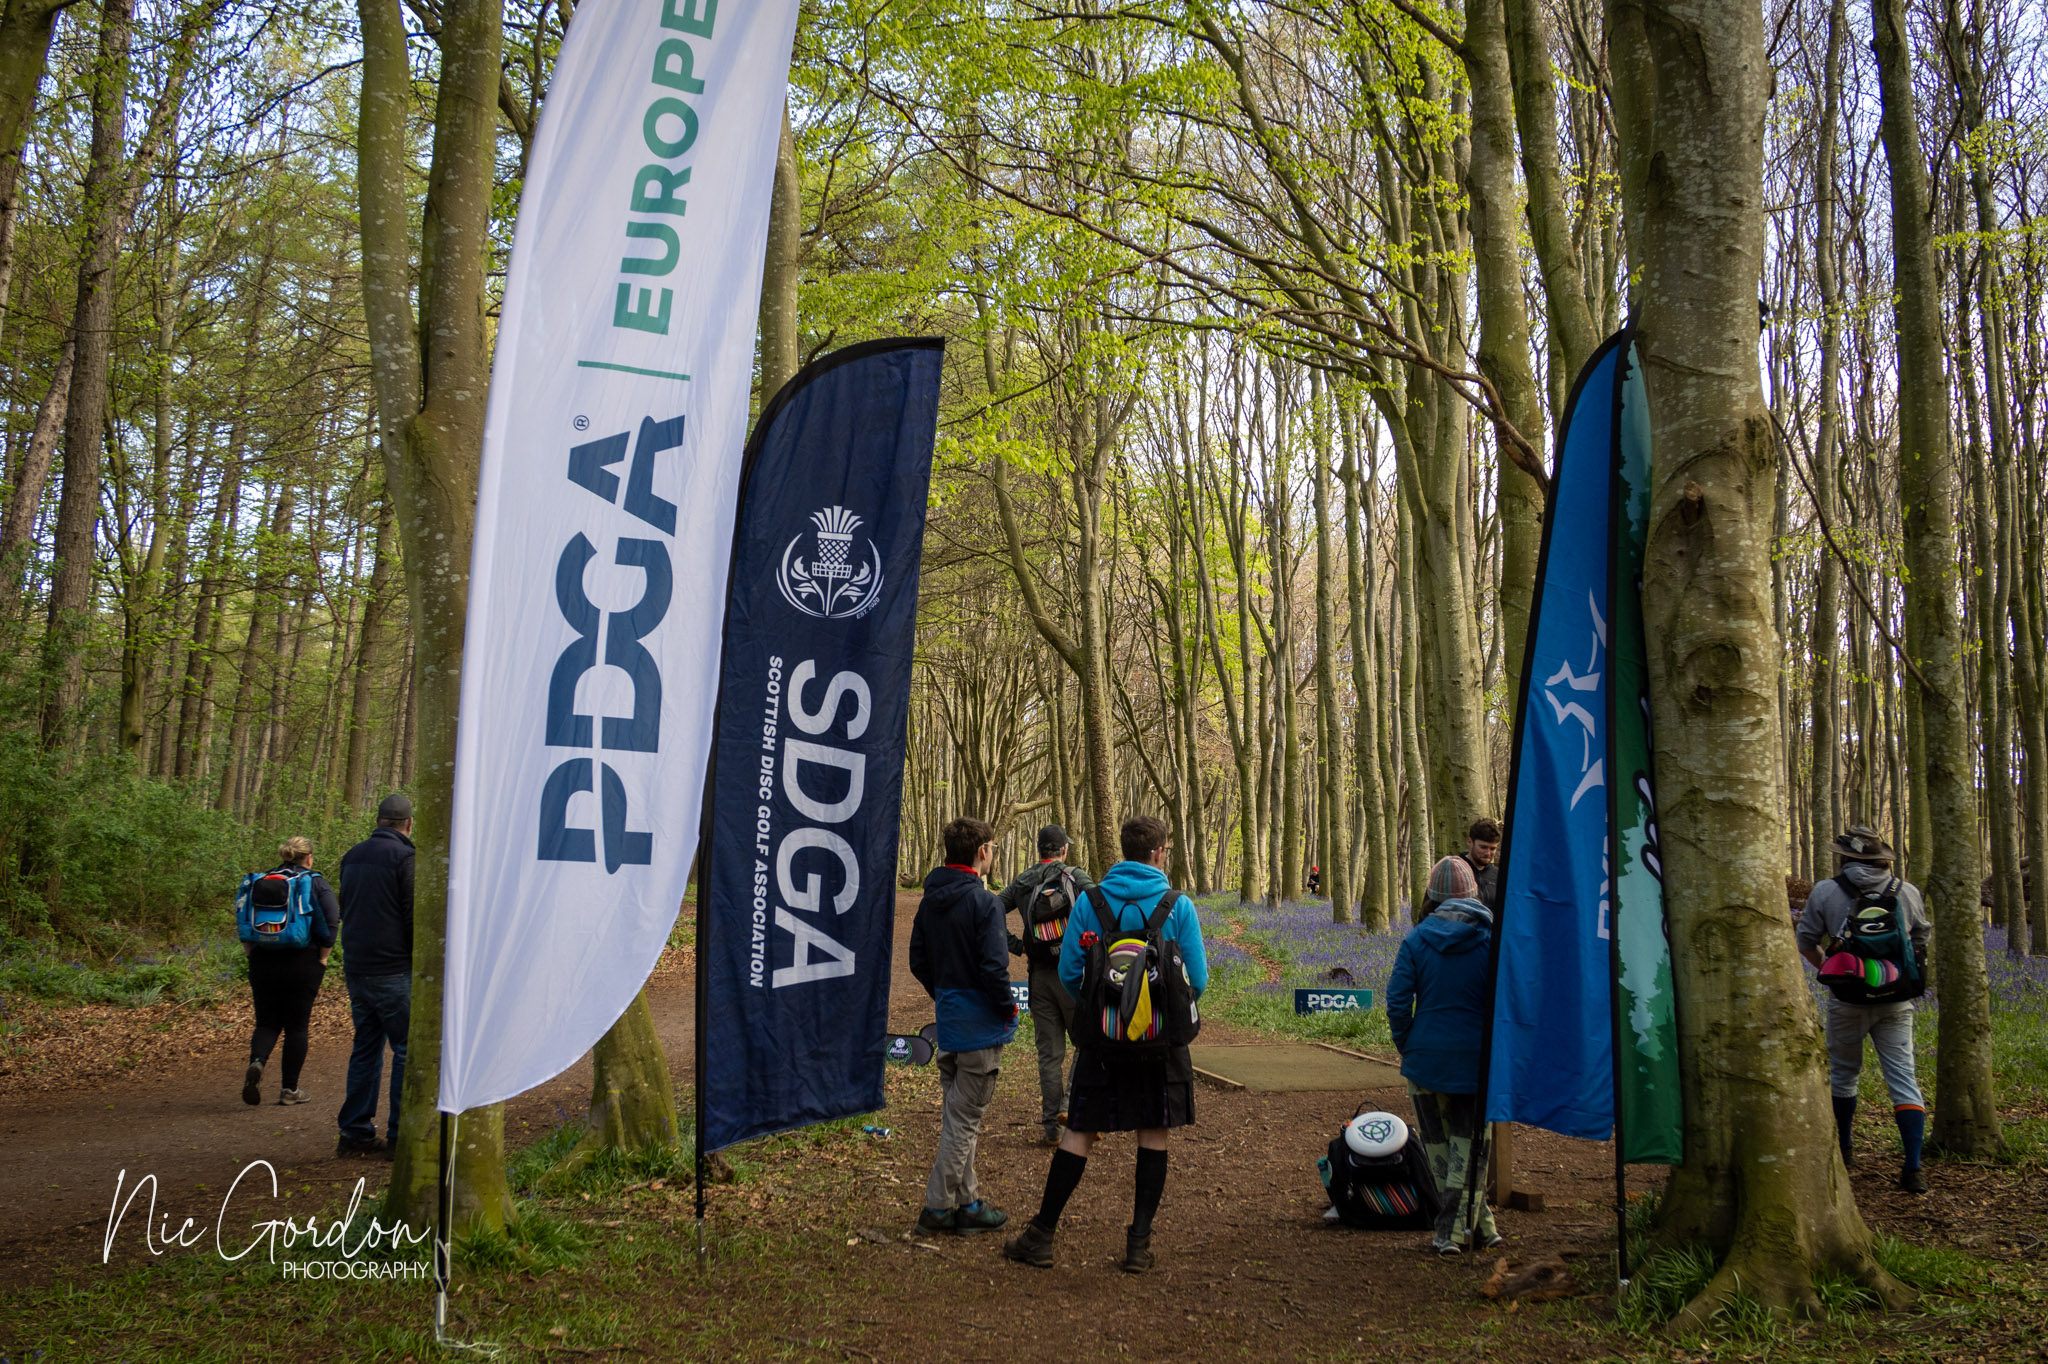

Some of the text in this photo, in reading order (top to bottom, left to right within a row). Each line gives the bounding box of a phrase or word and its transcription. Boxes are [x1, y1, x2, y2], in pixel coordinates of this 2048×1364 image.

[538, 0, 718, 875] PDGA EUROPE
[868, 596, 880, 611] 2020
[749, 655, 784, 988] SCOTTISH DISC GOLF ASSOCIATION
[772, 659, 872, 989] SDGA
[1307, 993, 1360, 1009] PDGA
